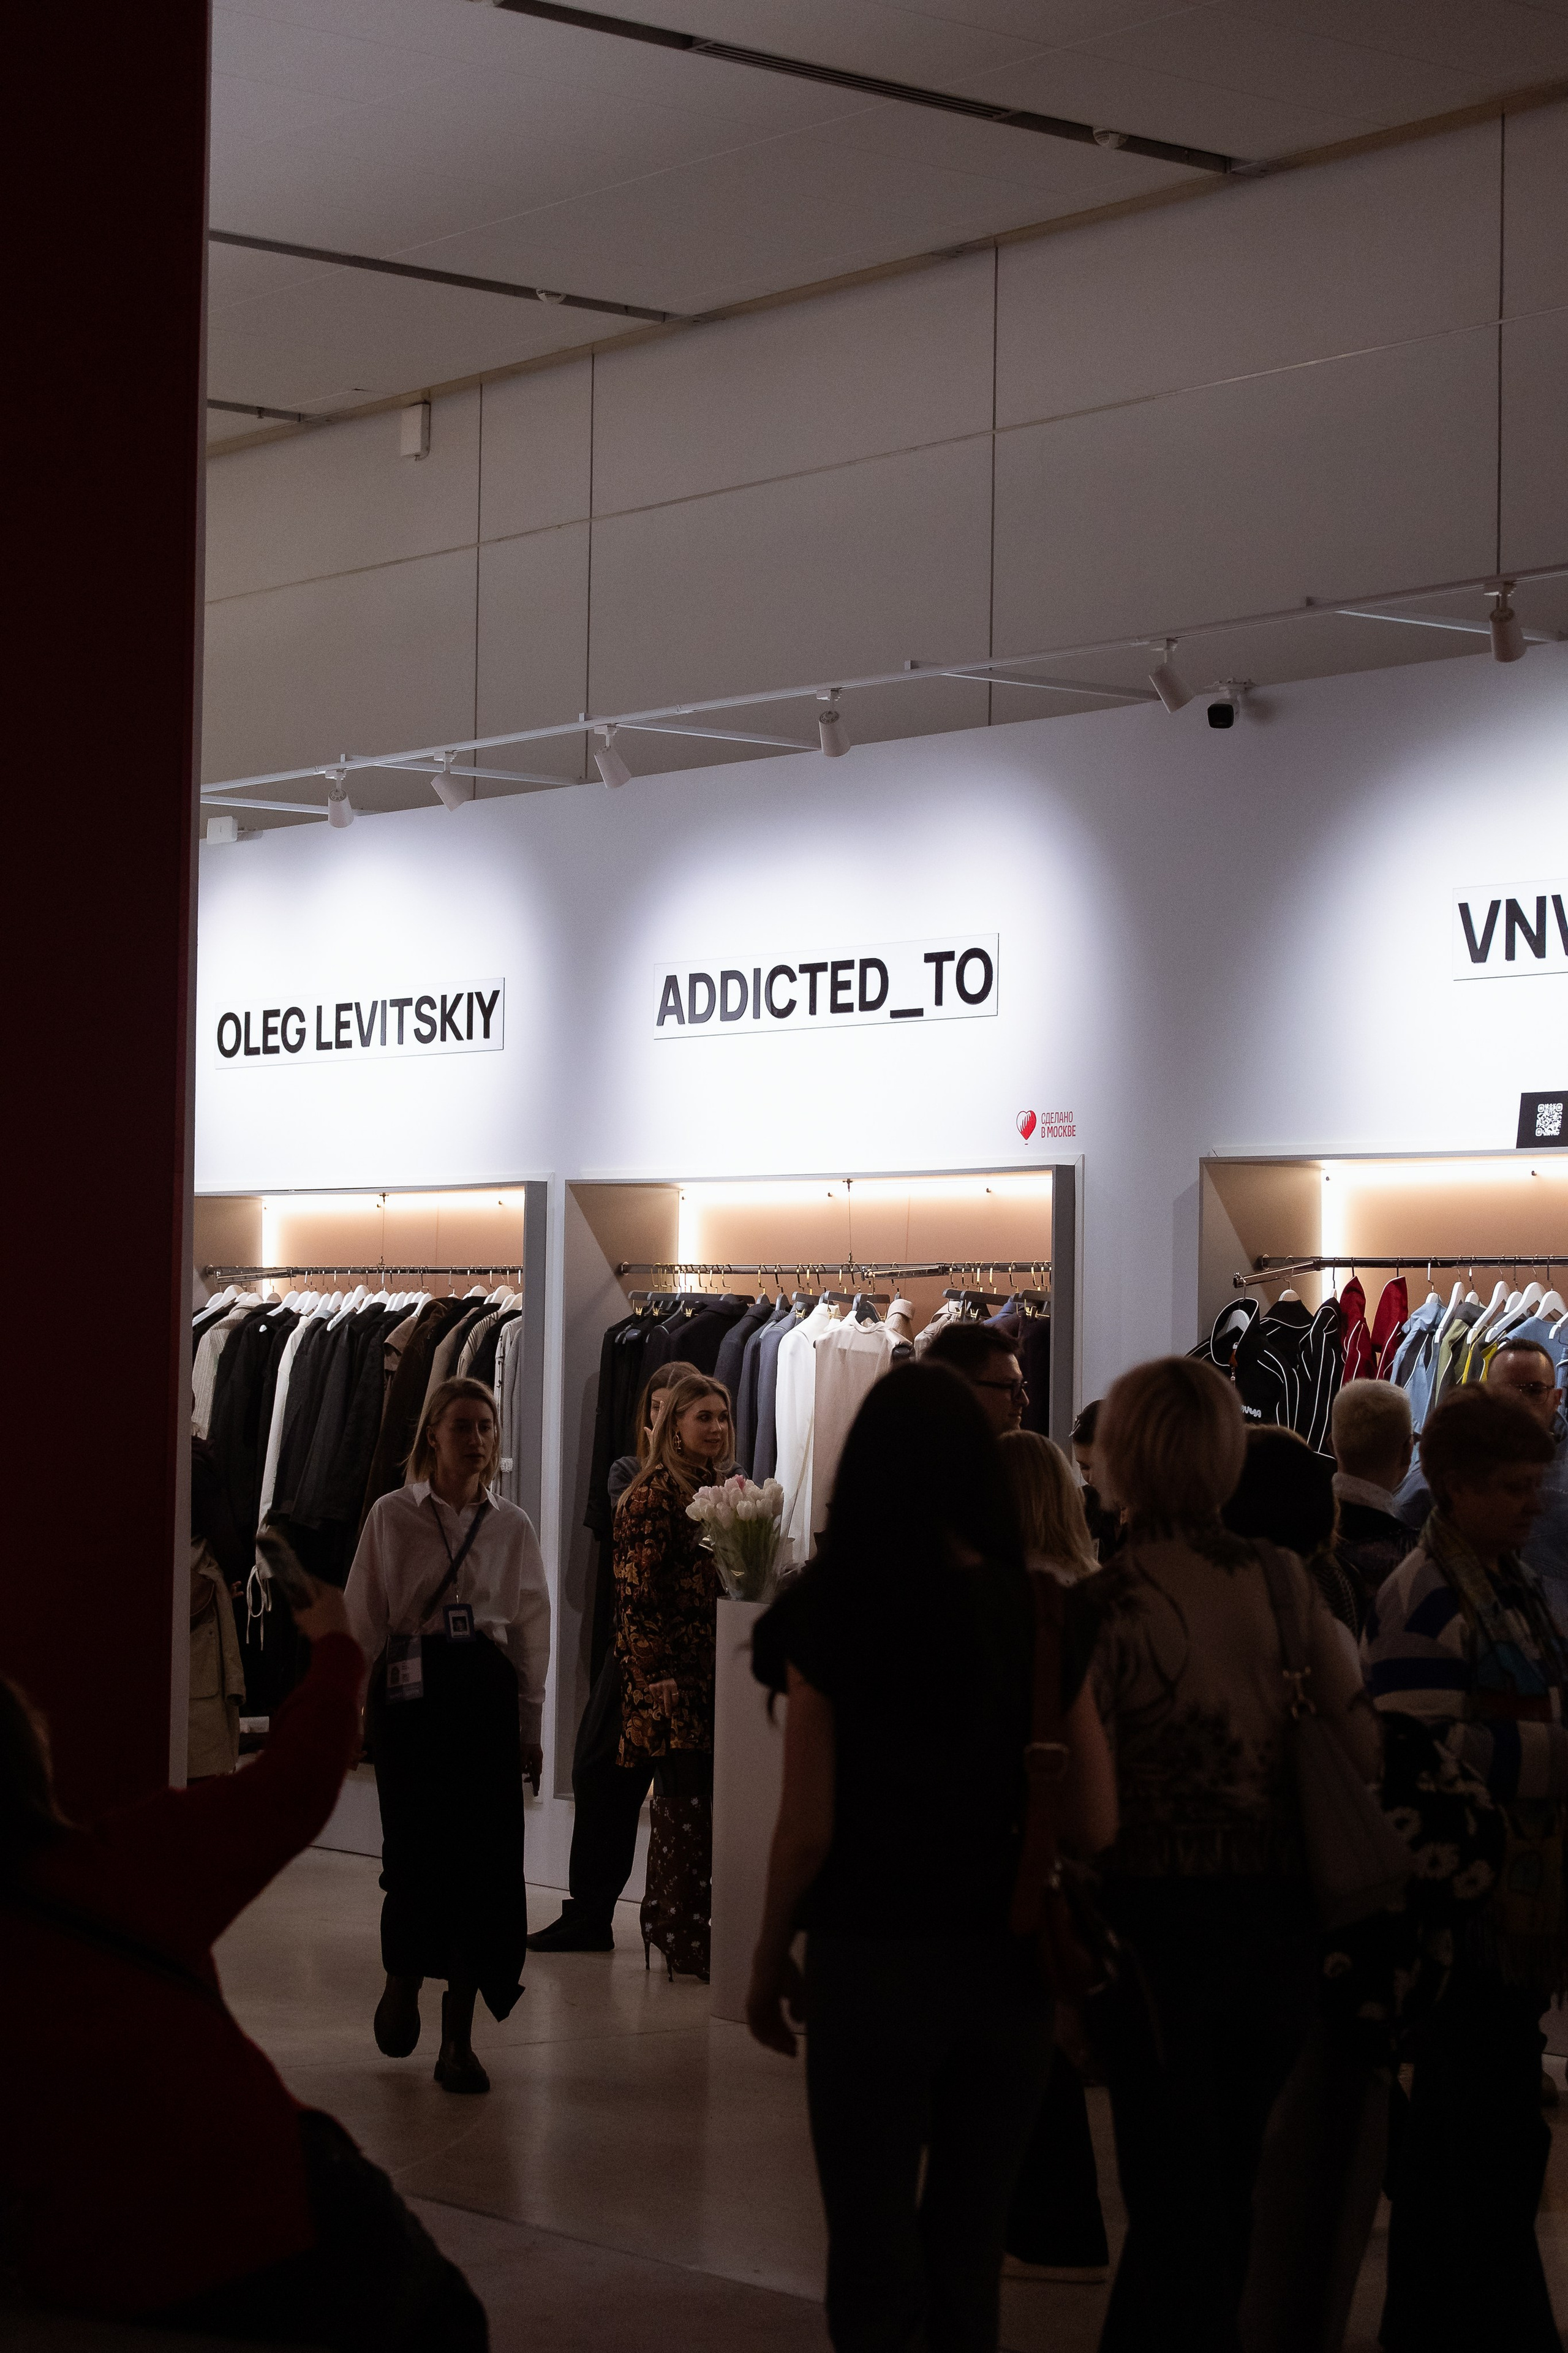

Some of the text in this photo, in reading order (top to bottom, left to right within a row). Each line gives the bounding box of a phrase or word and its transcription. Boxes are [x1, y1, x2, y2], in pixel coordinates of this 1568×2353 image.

[656, 948, 993, 1027] ADDICTED_TO
[217, 989, 500, 1059] OLEG LEVITSKIY
[1041, 1111, 1073, 1125] СДЕЛАНО
[1041, 1125, 1076, 1138] В МОСКВЕ
